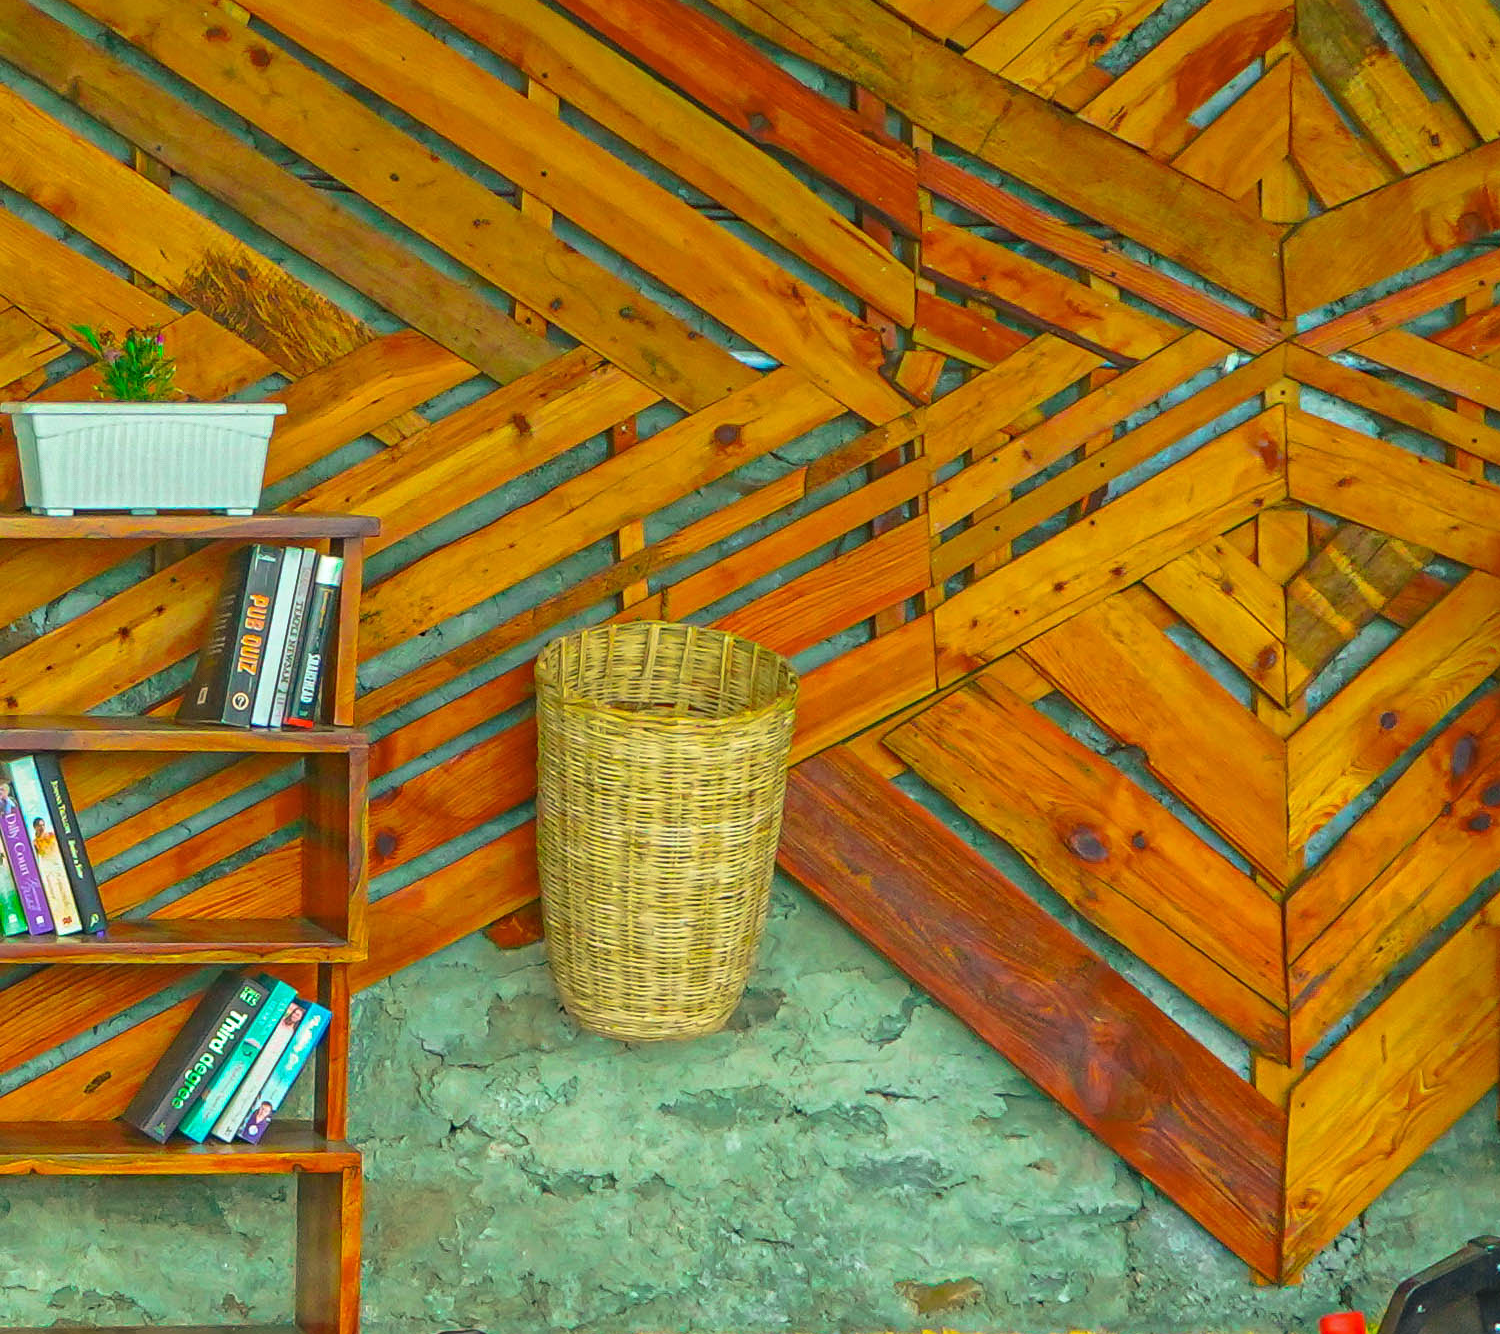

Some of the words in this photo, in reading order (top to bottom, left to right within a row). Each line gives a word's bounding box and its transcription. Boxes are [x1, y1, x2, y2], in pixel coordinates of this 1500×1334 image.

[244, 594, 270, 631] PUB
[237, 634, 262, 676] QUIZ
[4, 813, 20, 840] Dilly
[14, 842, 31, 876] Court
[208, 1010, 249, 1055] Third
[171, 1052, 216, 1110] degree
